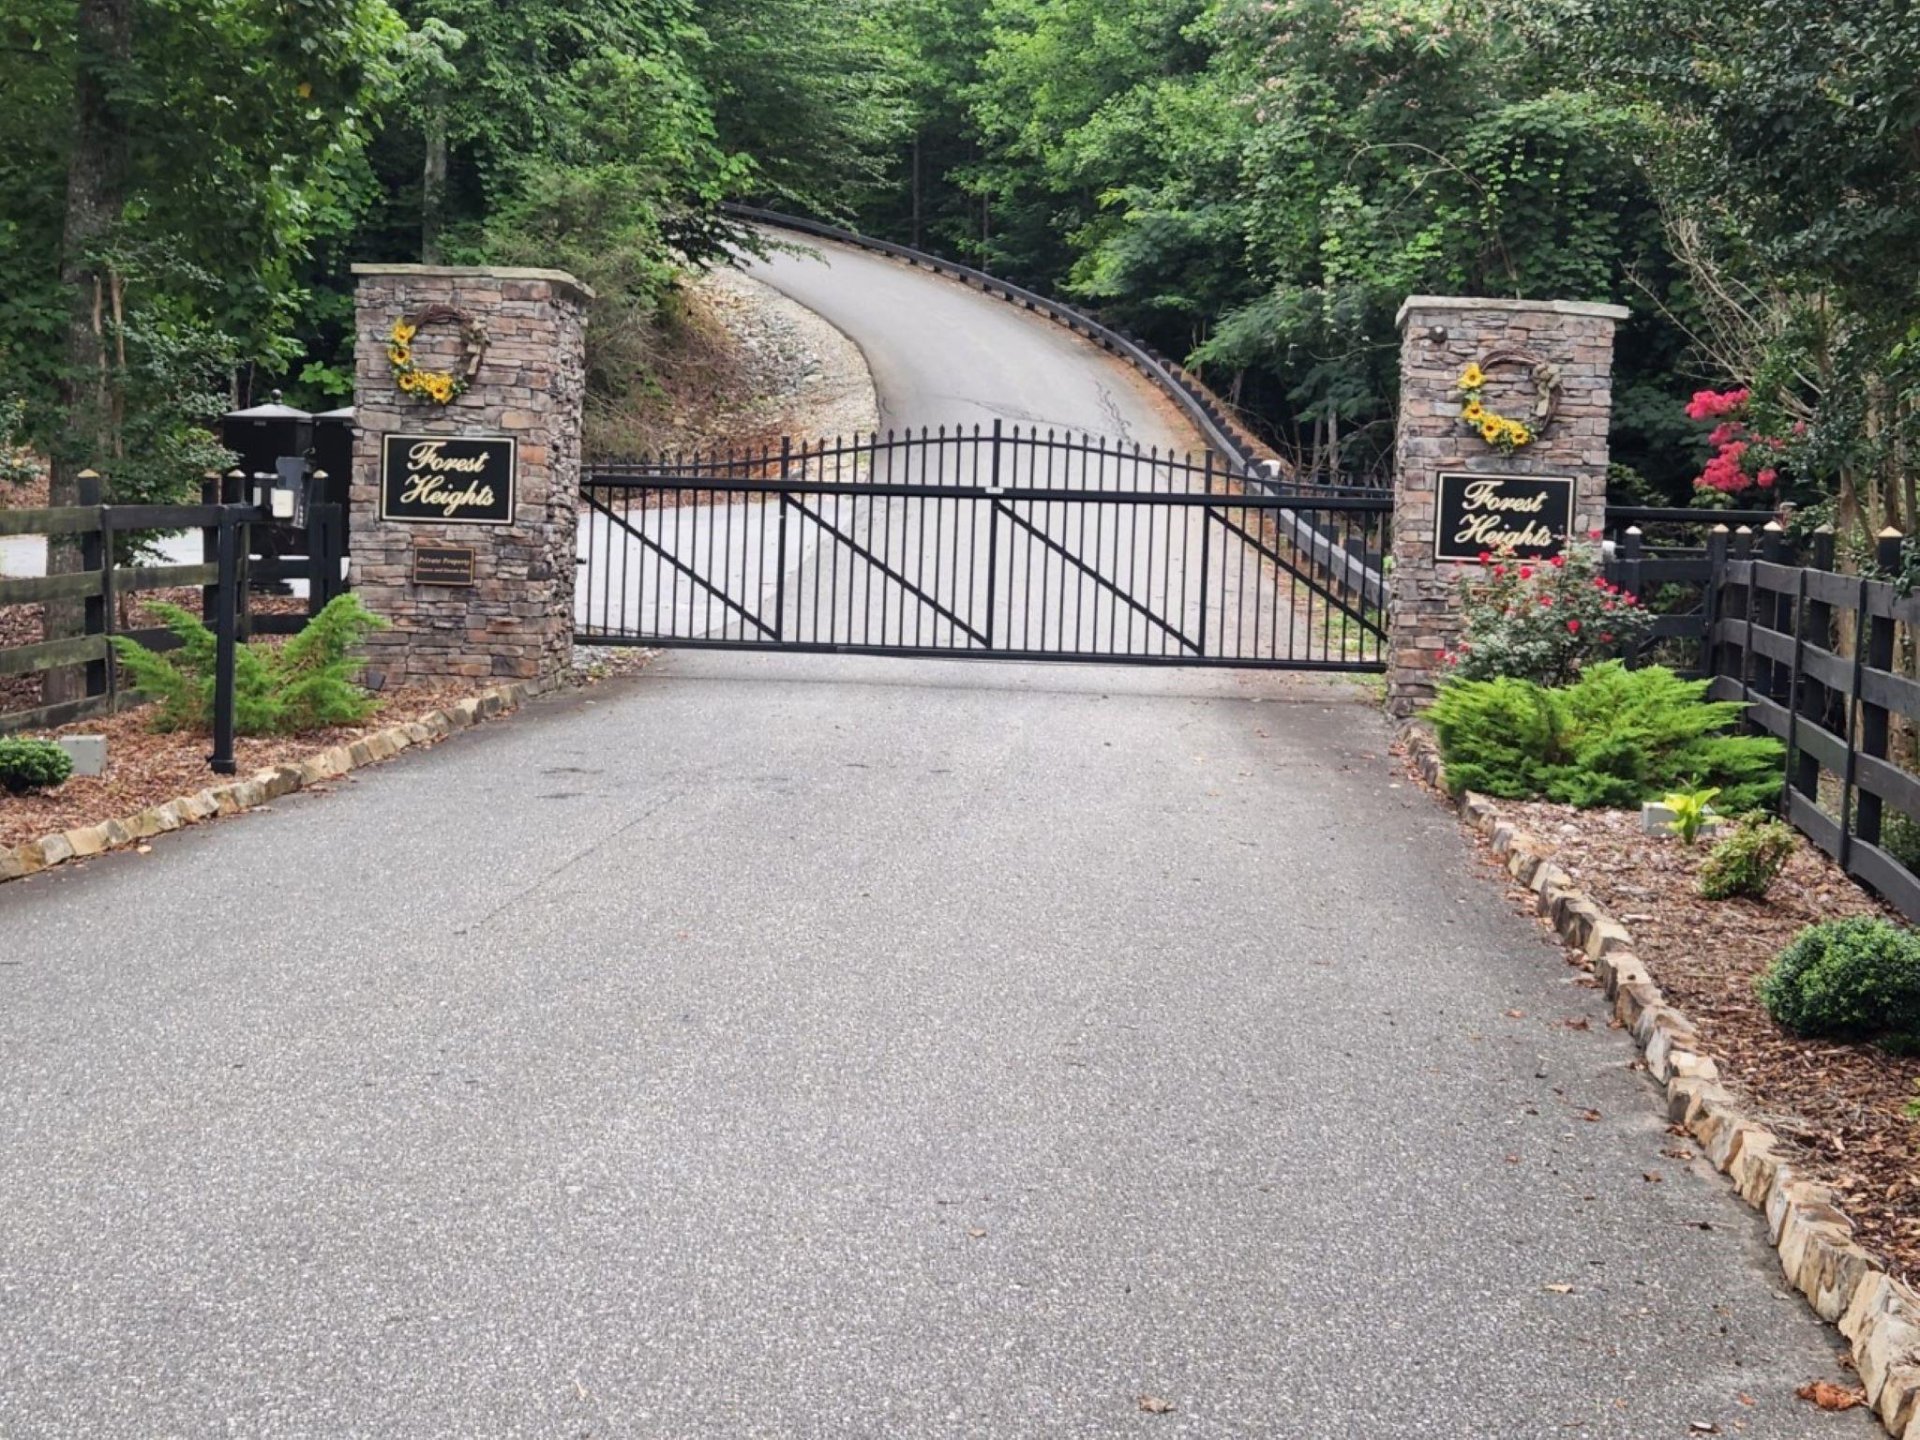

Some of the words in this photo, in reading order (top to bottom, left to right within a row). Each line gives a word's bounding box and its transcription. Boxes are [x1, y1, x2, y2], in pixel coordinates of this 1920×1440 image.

[407, 441, 490, 472] Forest
[400, 474, 495, 516] Heights
[1462, 480, 1548, 512] Forest
[1454, 513, 1552, 555] Heights
